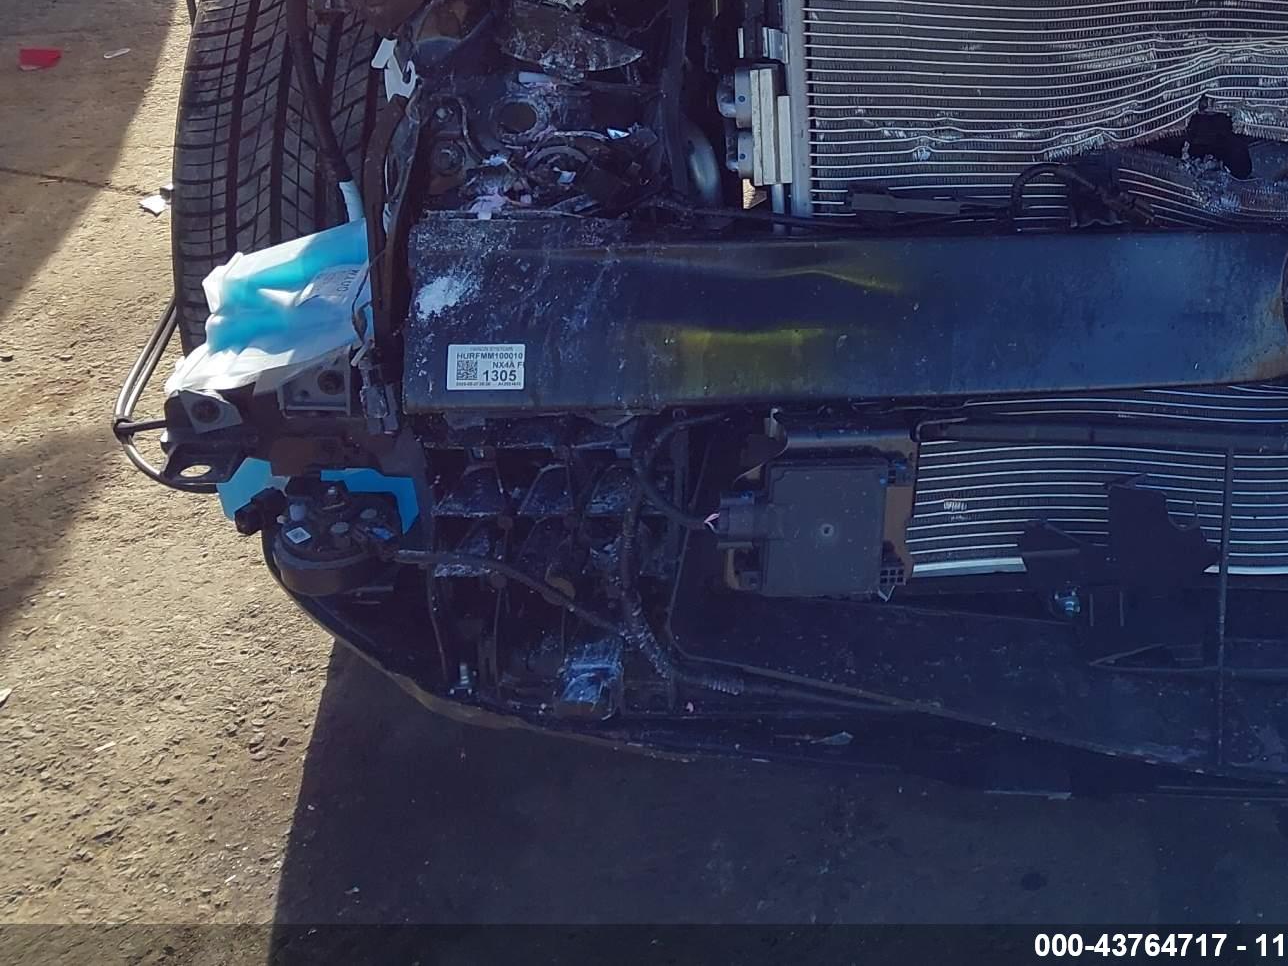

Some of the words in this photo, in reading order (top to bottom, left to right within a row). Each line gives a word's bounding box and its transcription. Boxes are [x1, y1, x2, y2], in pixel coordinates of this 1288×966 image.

[456, 352, 523, 360] HURFMM100010
[492, 361, 515, 369] NX4A
[482, 369, 517, 382] 1305
